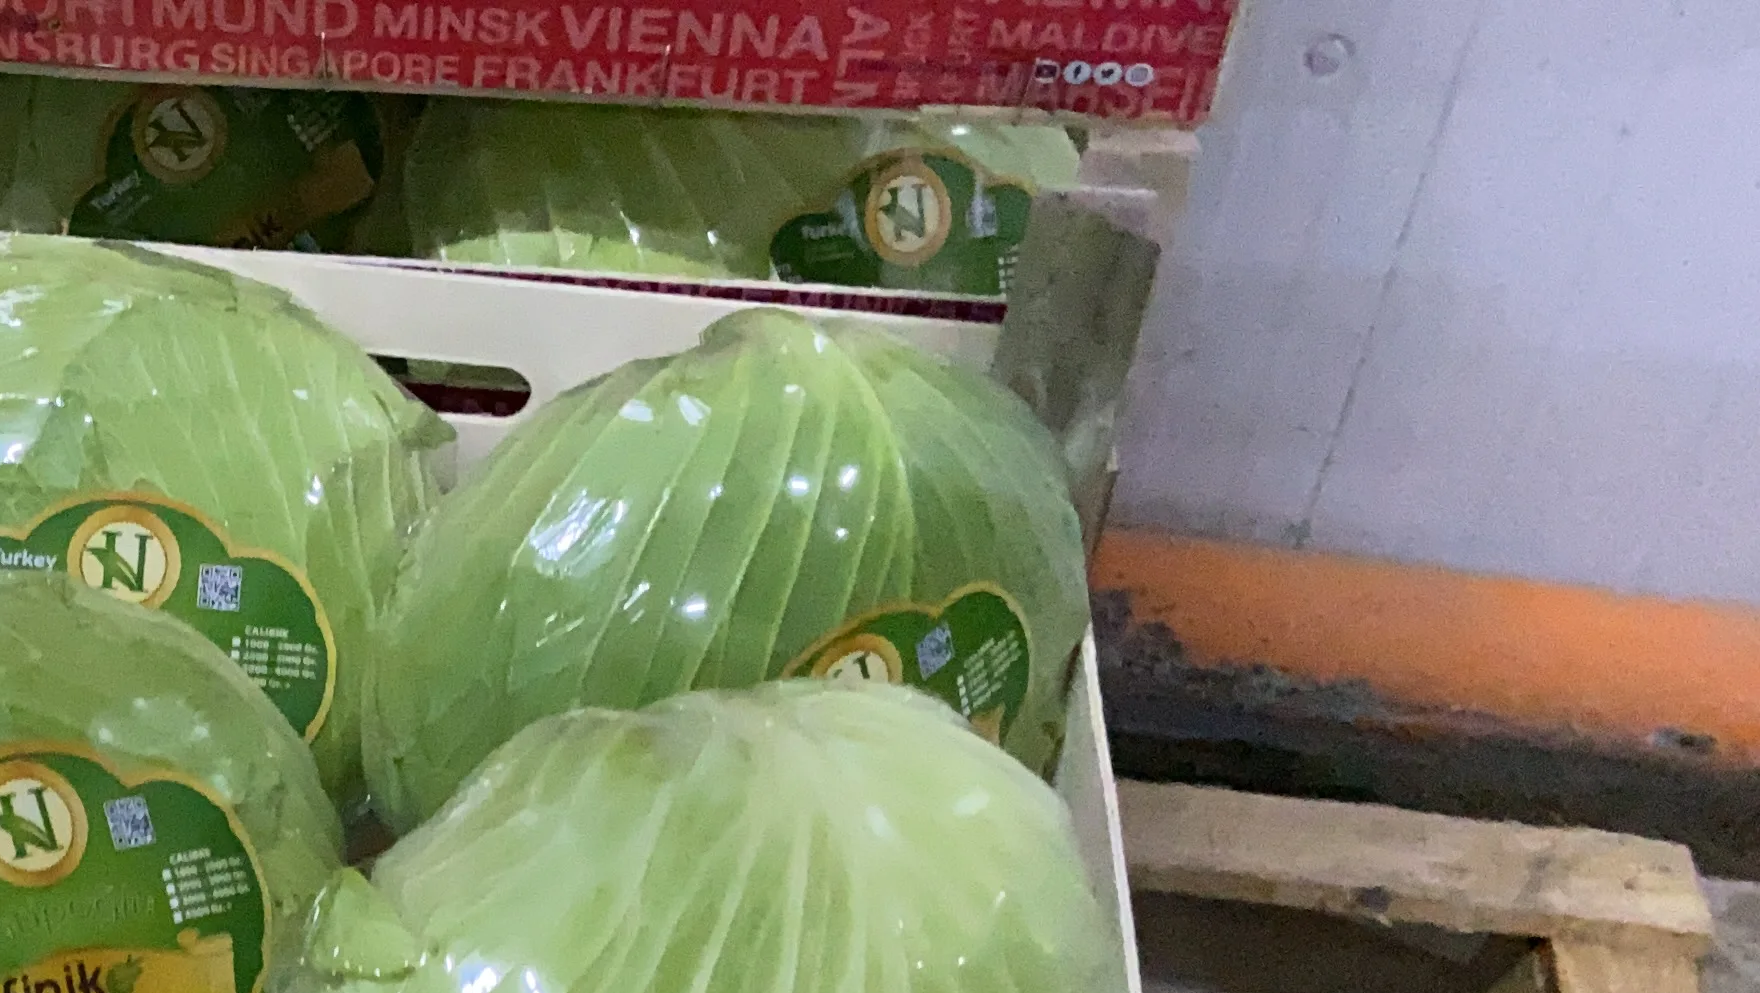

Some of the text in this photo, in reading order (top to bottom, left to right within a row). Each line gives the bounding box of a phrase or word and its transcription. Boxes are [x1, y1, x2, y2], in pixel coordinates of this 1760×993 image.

[374, 4, 551, 46] MINSK
[560, 4, 829, 62] VIENNA
[210, 42, 460, 87] SINGAPORE
[473, 55, 820, 107] FRANKFURT
